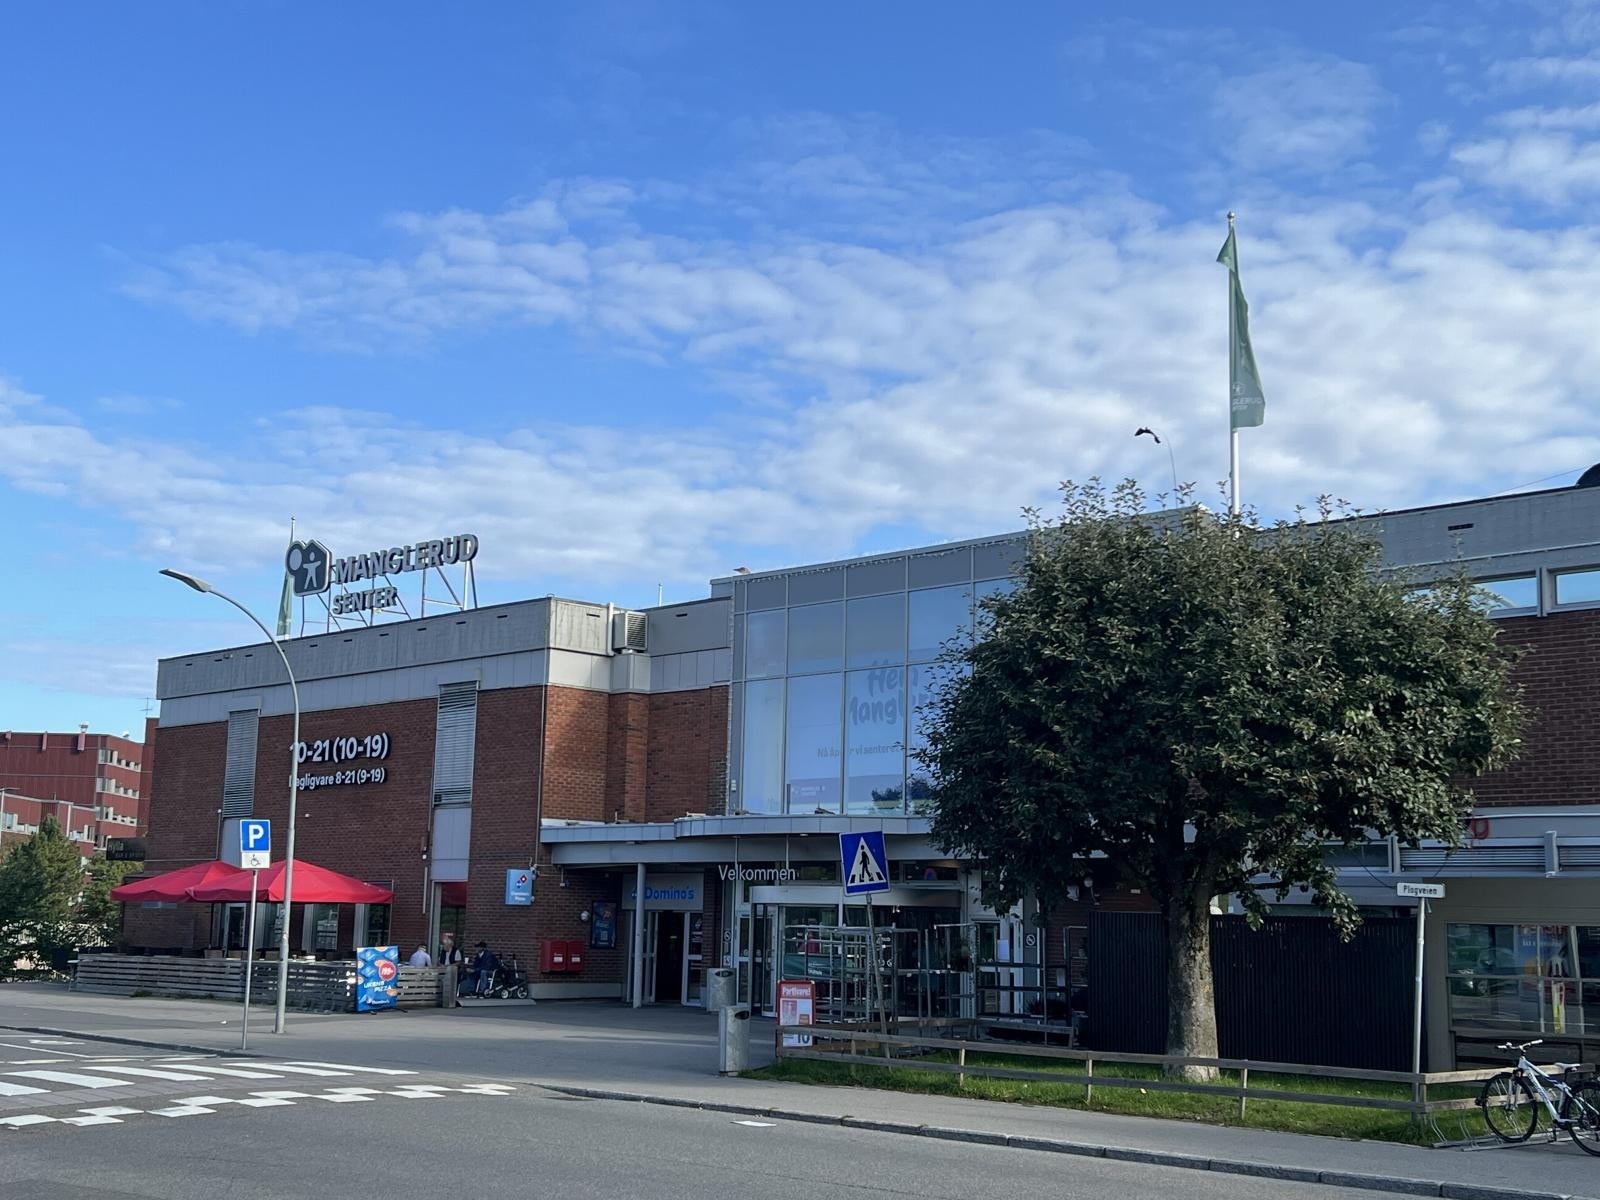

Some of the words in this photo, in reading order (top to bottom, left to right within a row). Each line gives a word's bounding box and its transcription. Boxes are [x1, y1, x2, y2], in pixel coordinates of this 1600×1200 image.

[334, 533, 479, 585] MANGLERUD
[332, 586, 398, 615] SENTER
[332, 731, 389, 763] (10-19)
[335, 770, 356, 785] 8-21
[356, 766, 385, 785] (9-19)
[248, 824, 264, 849] P
[718, 863, 796, 881] Velkommen
[644, 885, 695, 901] Domino's
